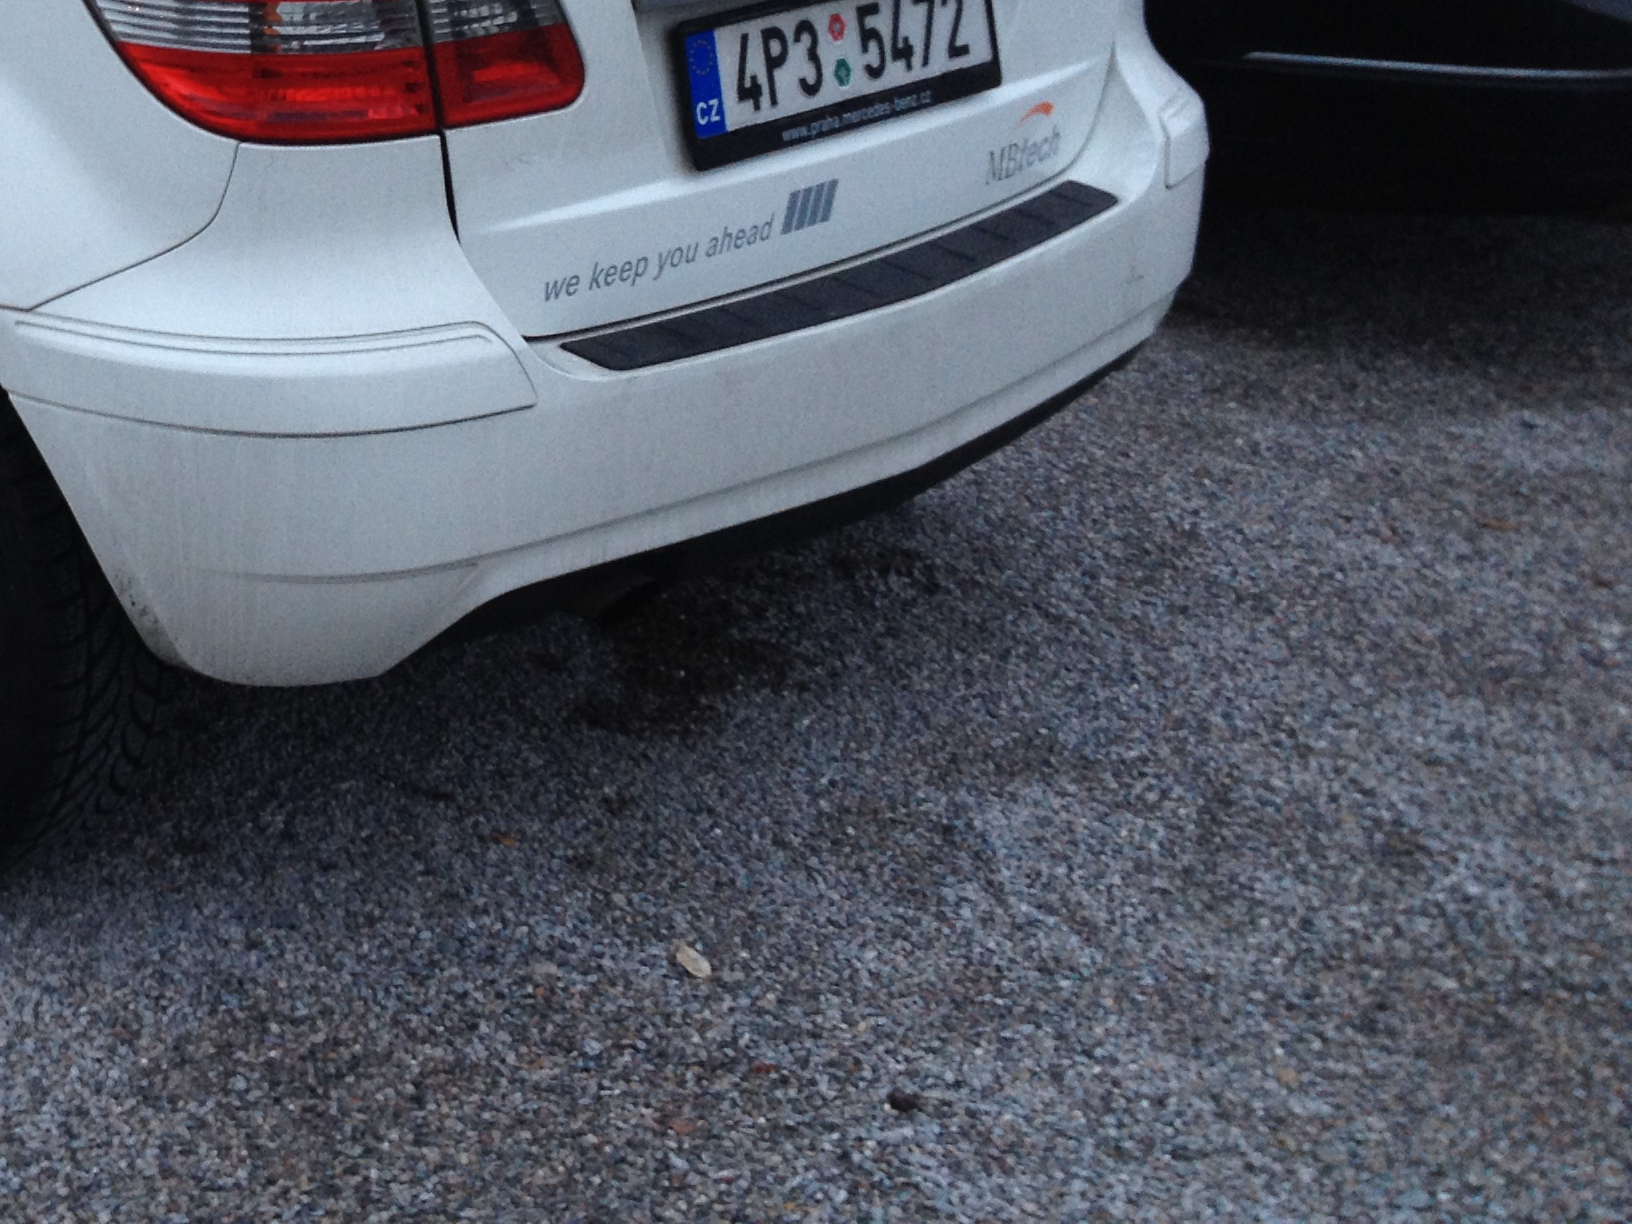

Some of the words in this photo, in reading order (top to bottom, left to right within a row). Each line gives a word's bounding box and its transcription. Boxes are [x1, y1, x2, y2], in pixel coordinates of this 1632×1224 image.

[737, 19, 823, 112] 4P3
[696, 99, 720, 125] CZ
[985, 124, 1061, 185] MBtech
[545, 274, 581, 302] we
[589, 261, 649, 287] keep
[653, 242, 699, 281] you
[705, 213, 775, 259] ahead
